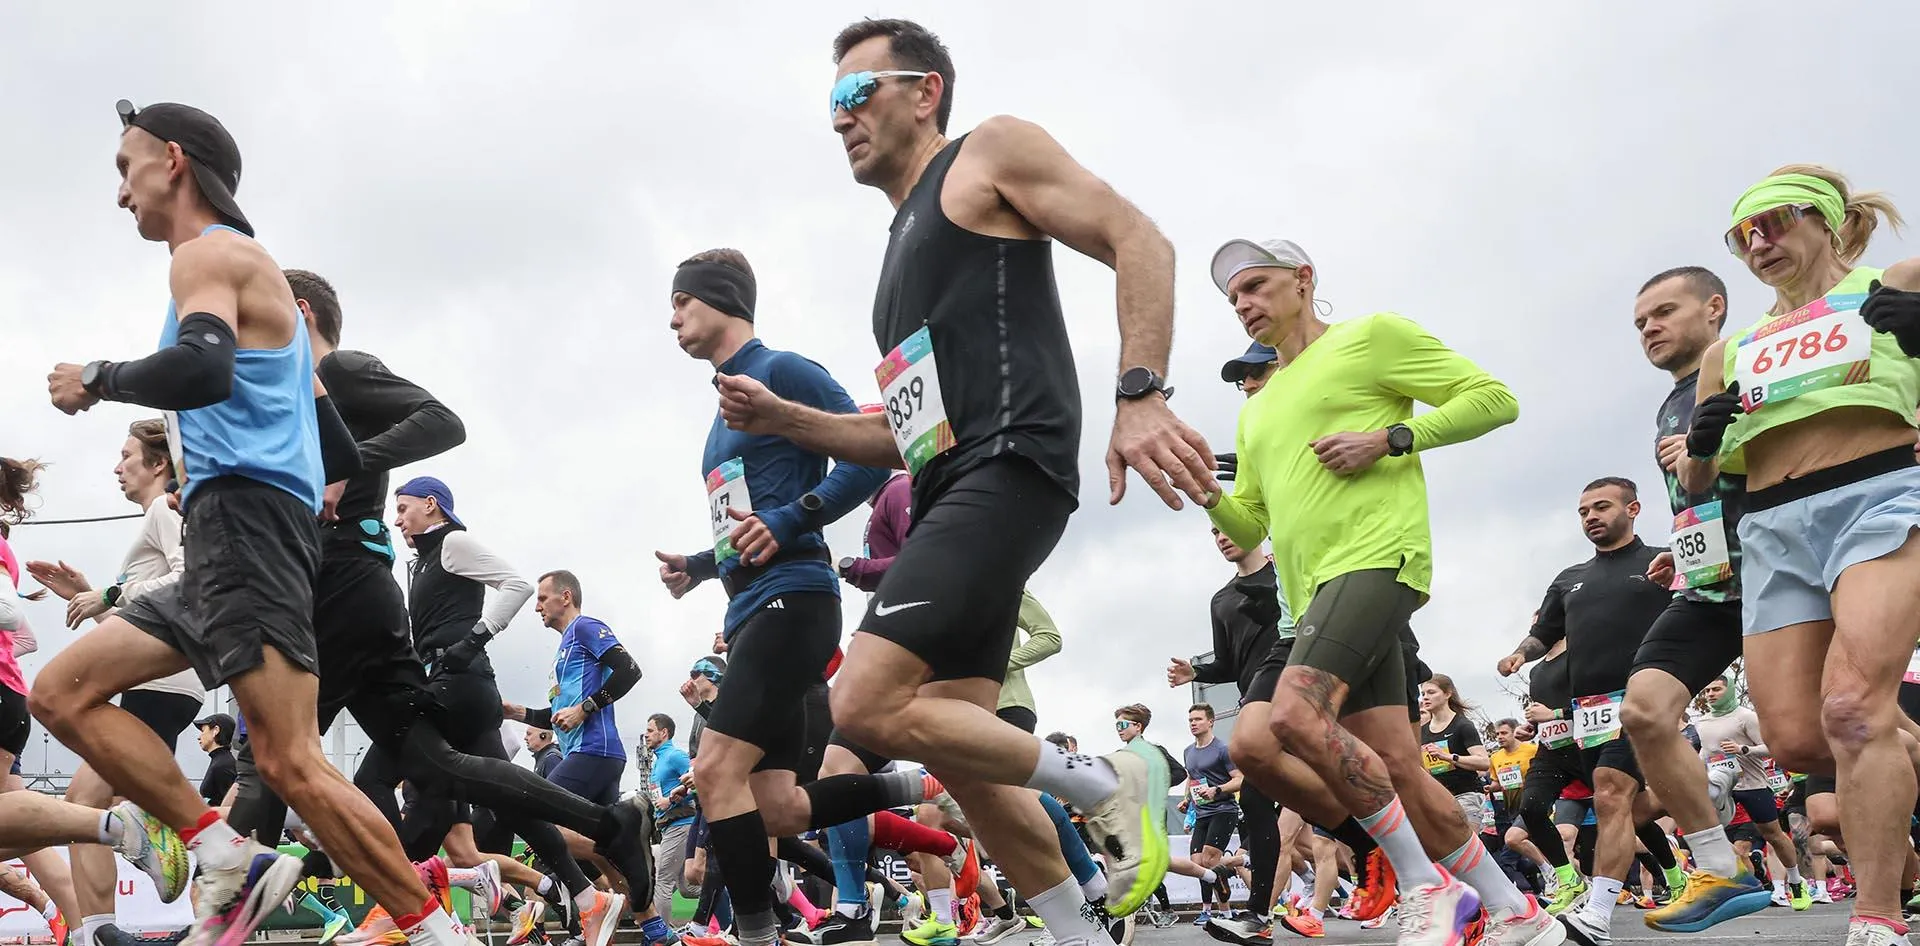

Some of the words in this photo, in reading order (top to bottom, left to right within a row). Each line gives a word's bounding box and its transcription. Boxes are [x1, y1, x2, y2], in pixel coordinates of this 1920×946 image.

[1752, 323, 1848, 374] 6786
[1751, 386, 1763, 403] B
[886, 376, 923, 434] 839
[710, 492, 729, 529] 47
[1676, 531, 1706, 559] 358
[1582, 708, 1612, 727] 315
[1541, 722, 1568, 738] 6720
[1501, 772, 1517, 782] 4470
[118, 880, 134, 896] u
